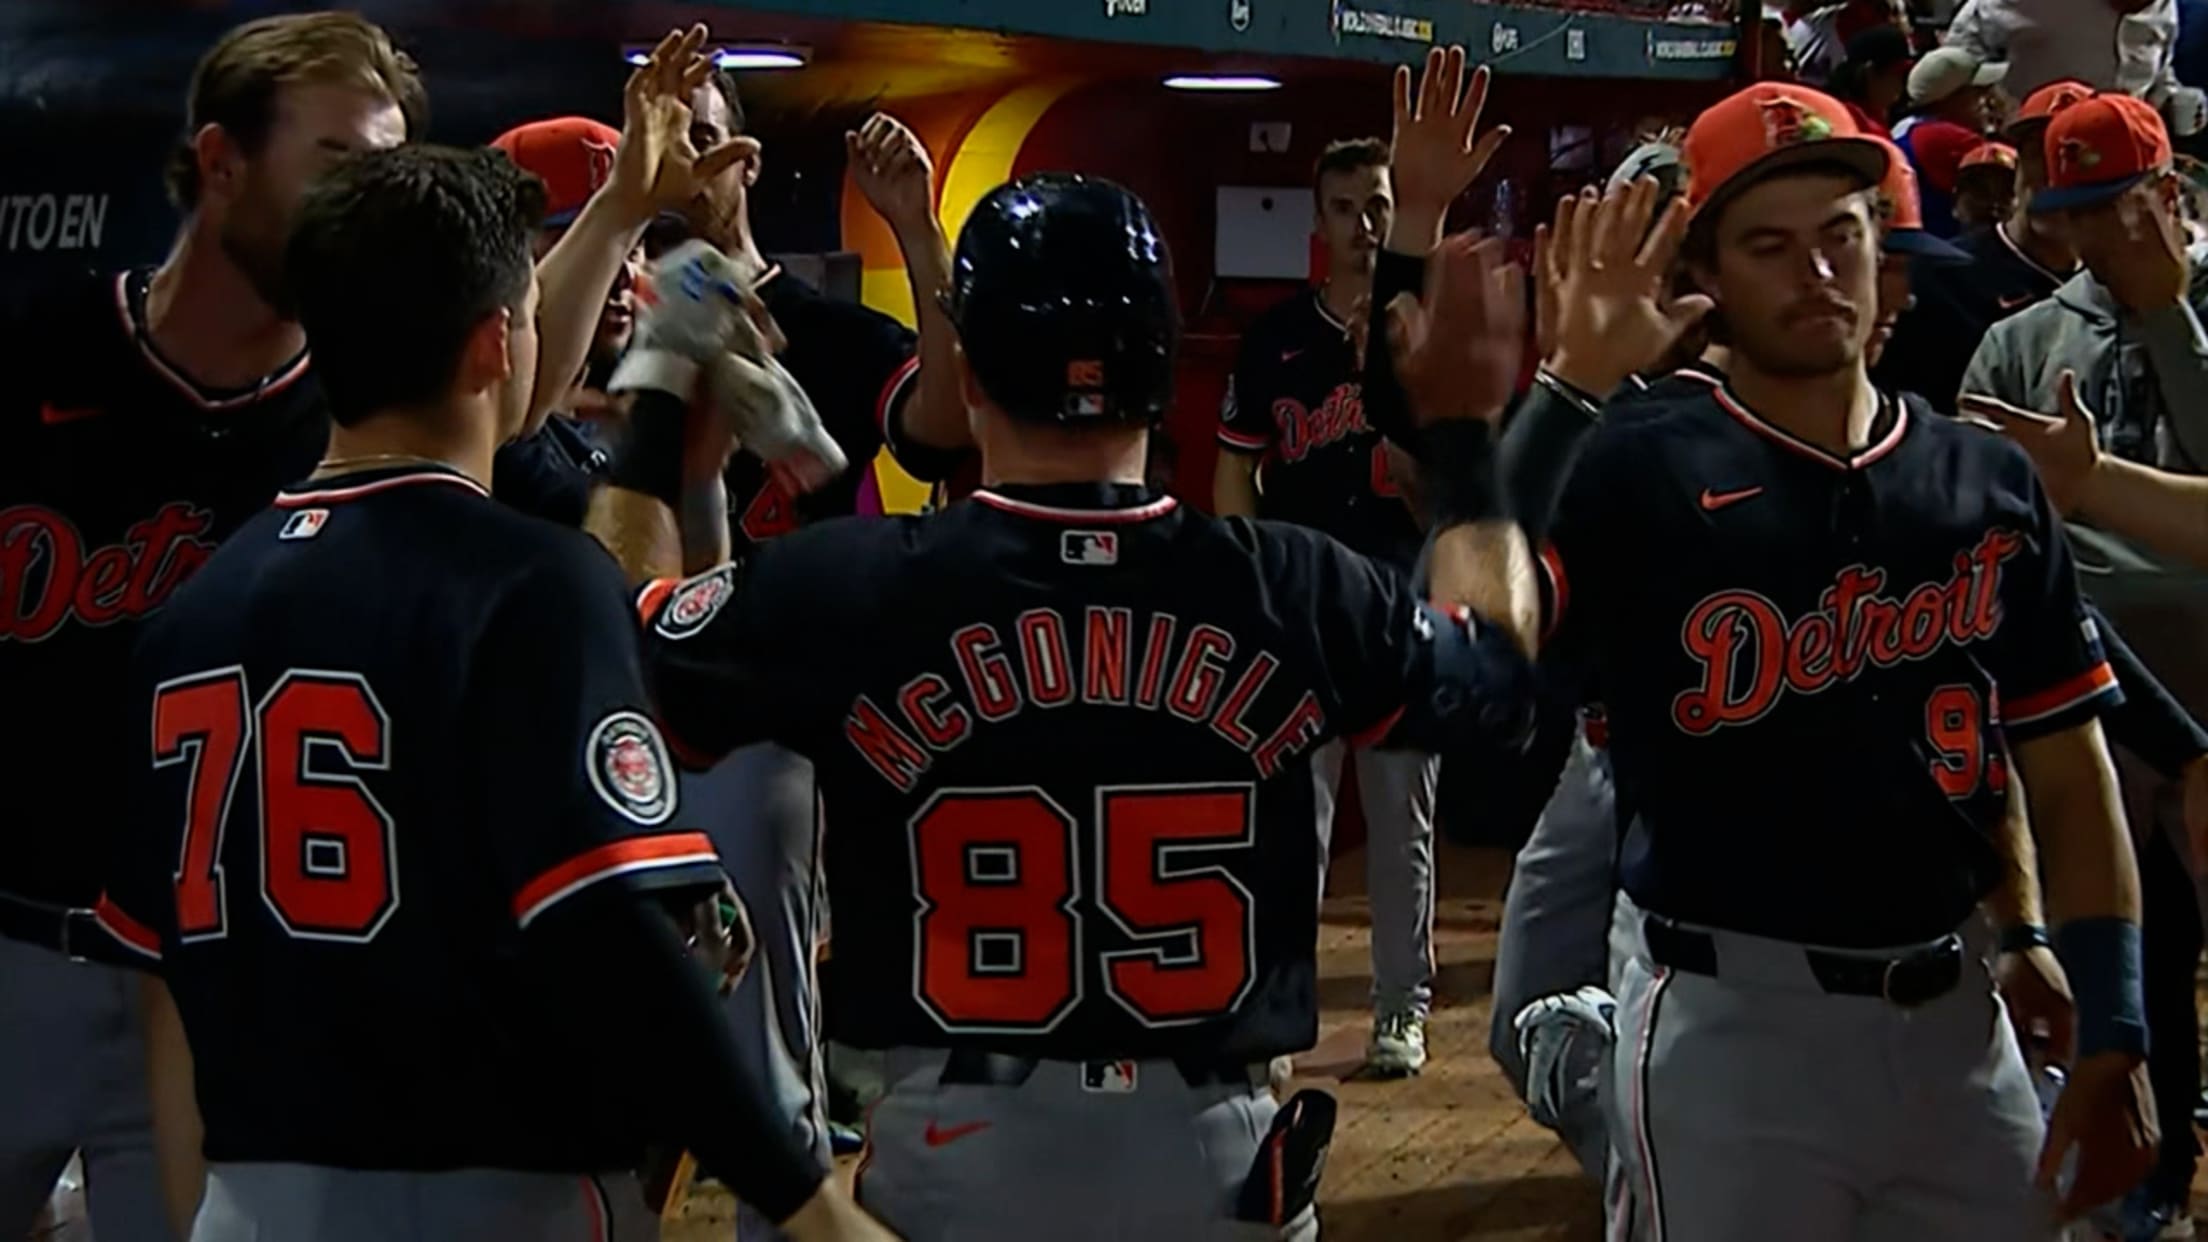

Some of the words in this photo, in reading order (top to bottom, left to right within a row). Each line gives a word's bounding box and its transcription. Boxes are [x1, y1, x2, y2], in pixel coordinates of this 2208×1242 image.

[57, 193, 110, 248] EN
[1271, 383, 1366, 463] Detr
[0, 500, 217, 643] Detr
[1671, 526, 2022, 735] Detroit
[152, 664, 400, 943] 76
[907, 782, 1256, 1033] 85
